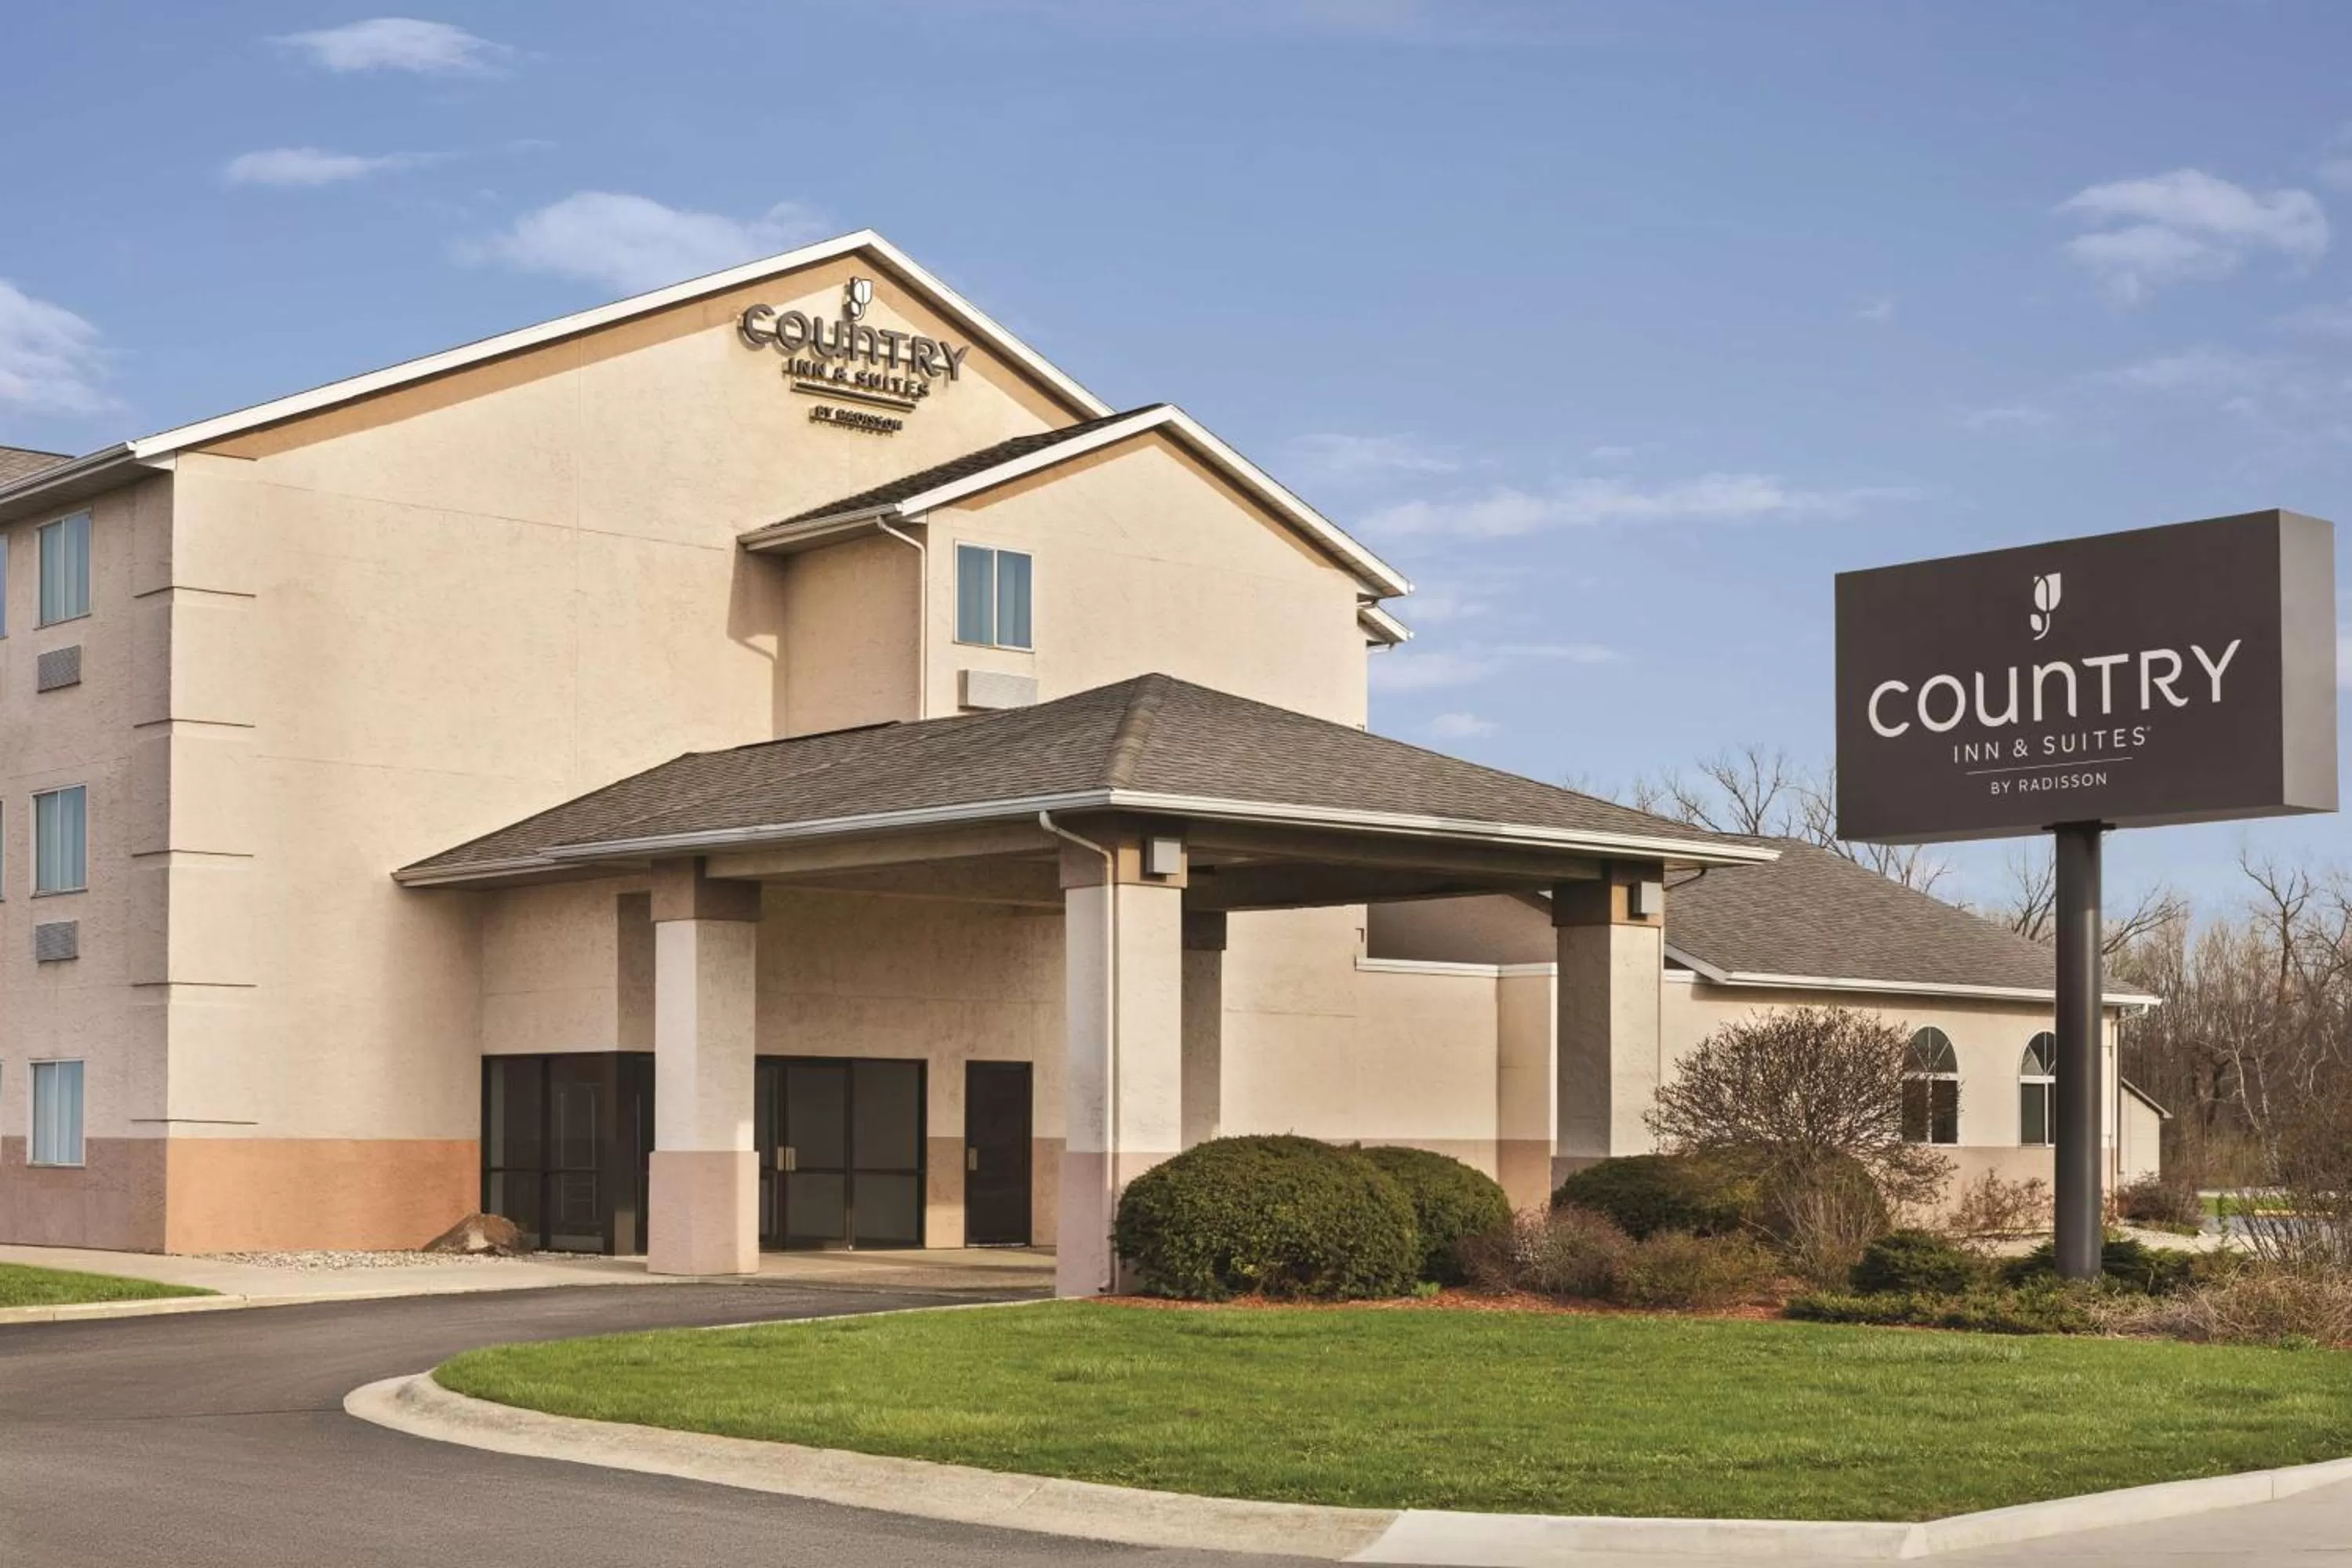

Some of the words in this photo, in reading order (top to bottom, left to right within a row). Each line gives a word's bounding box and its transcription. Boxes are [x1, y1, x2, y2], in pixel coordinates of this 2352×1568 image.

[788, 357, 825, 378] INN
[833, 367, 848, 380] &
[855, 370, 930, 398] SUITES
[815, 405, 833, 418] BY
[835, 408, 903, 431] RADISSON
[1953, 742, 1999, 763] INN
[2013, 738, 2029, 757] &
[1991, 780, 2010, 795] BY
[2019, 772, 2107, 792] RADISSON
